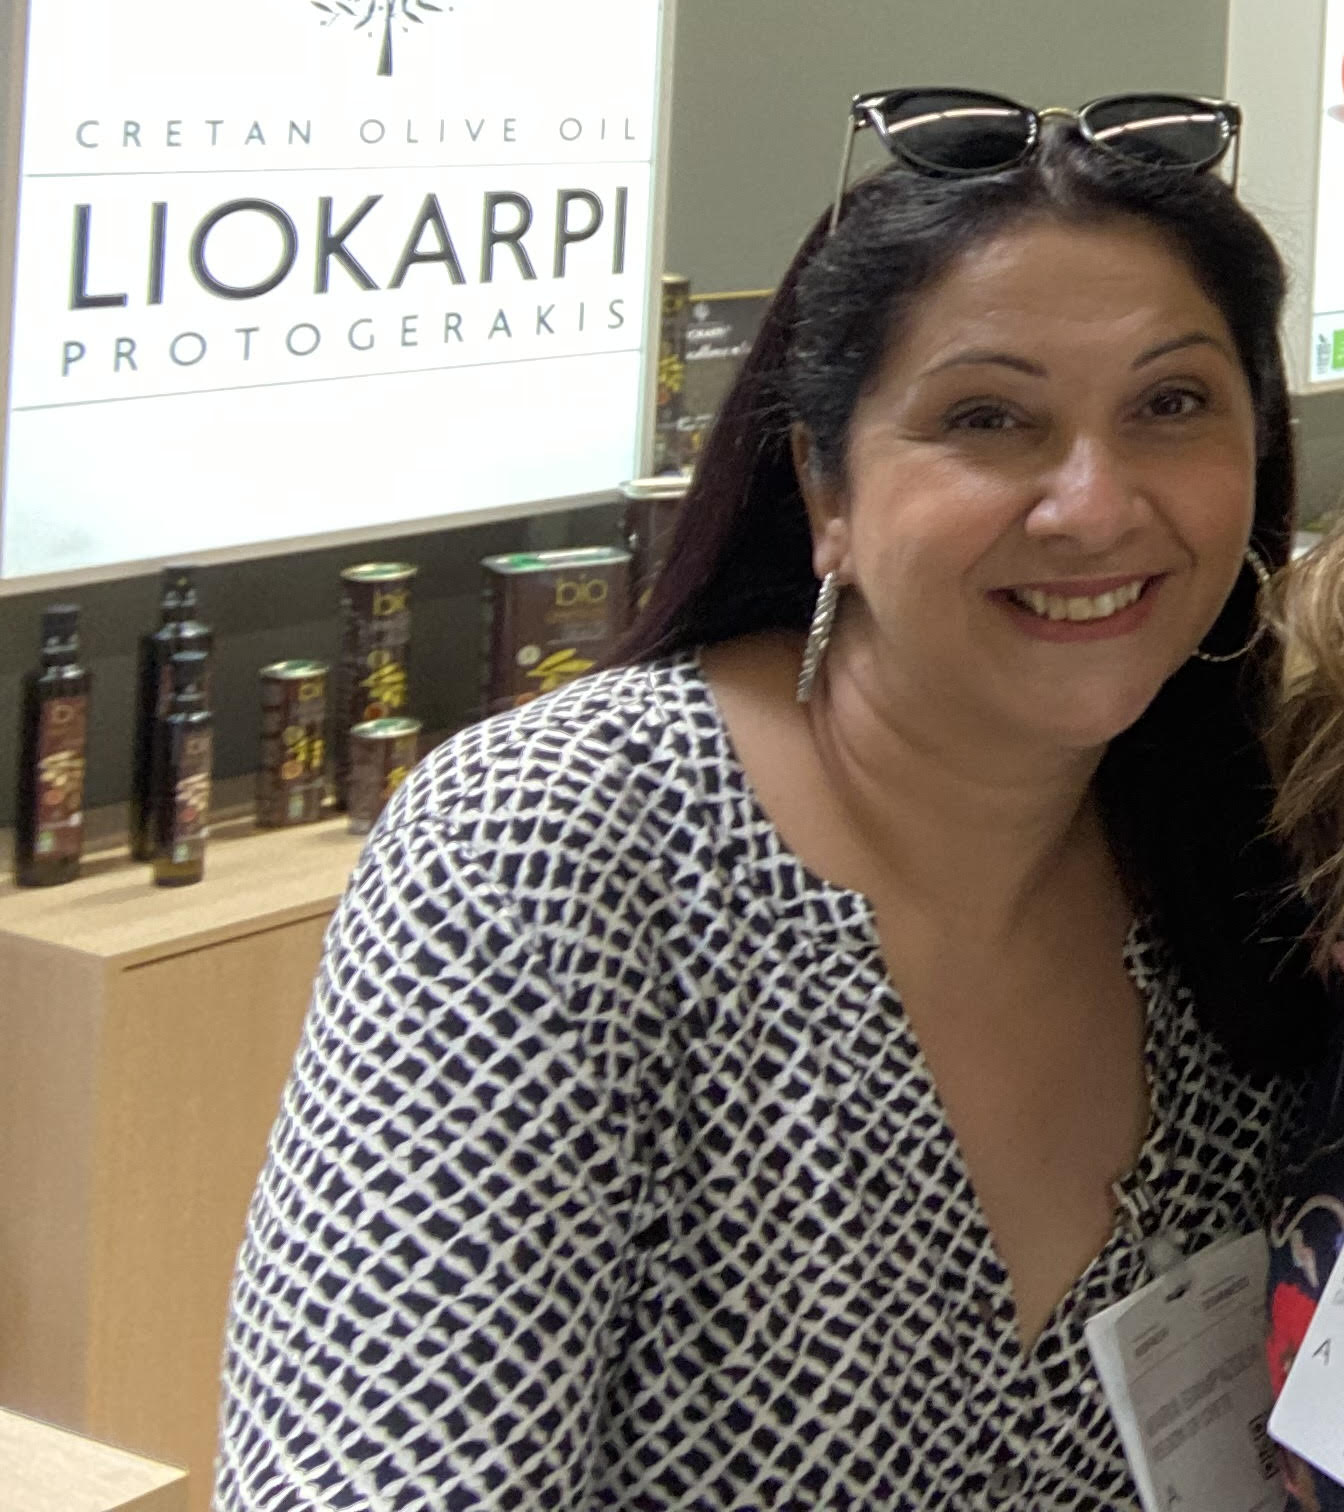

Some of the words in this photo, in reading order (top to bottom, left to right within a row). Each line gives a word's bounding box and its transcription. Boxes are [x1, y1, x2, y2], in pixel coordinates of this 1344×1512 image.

[75, 119, 312, 149] CRETAN
[358, 118, 518, 145] OLIVE
[559, 117, 637, 142] OIL
[67, 186, 629, 311] LIOKARPI
[61, 298, 626, 378] PROTOGERAKIS
[1311, 1337, 1332, 1366] A
